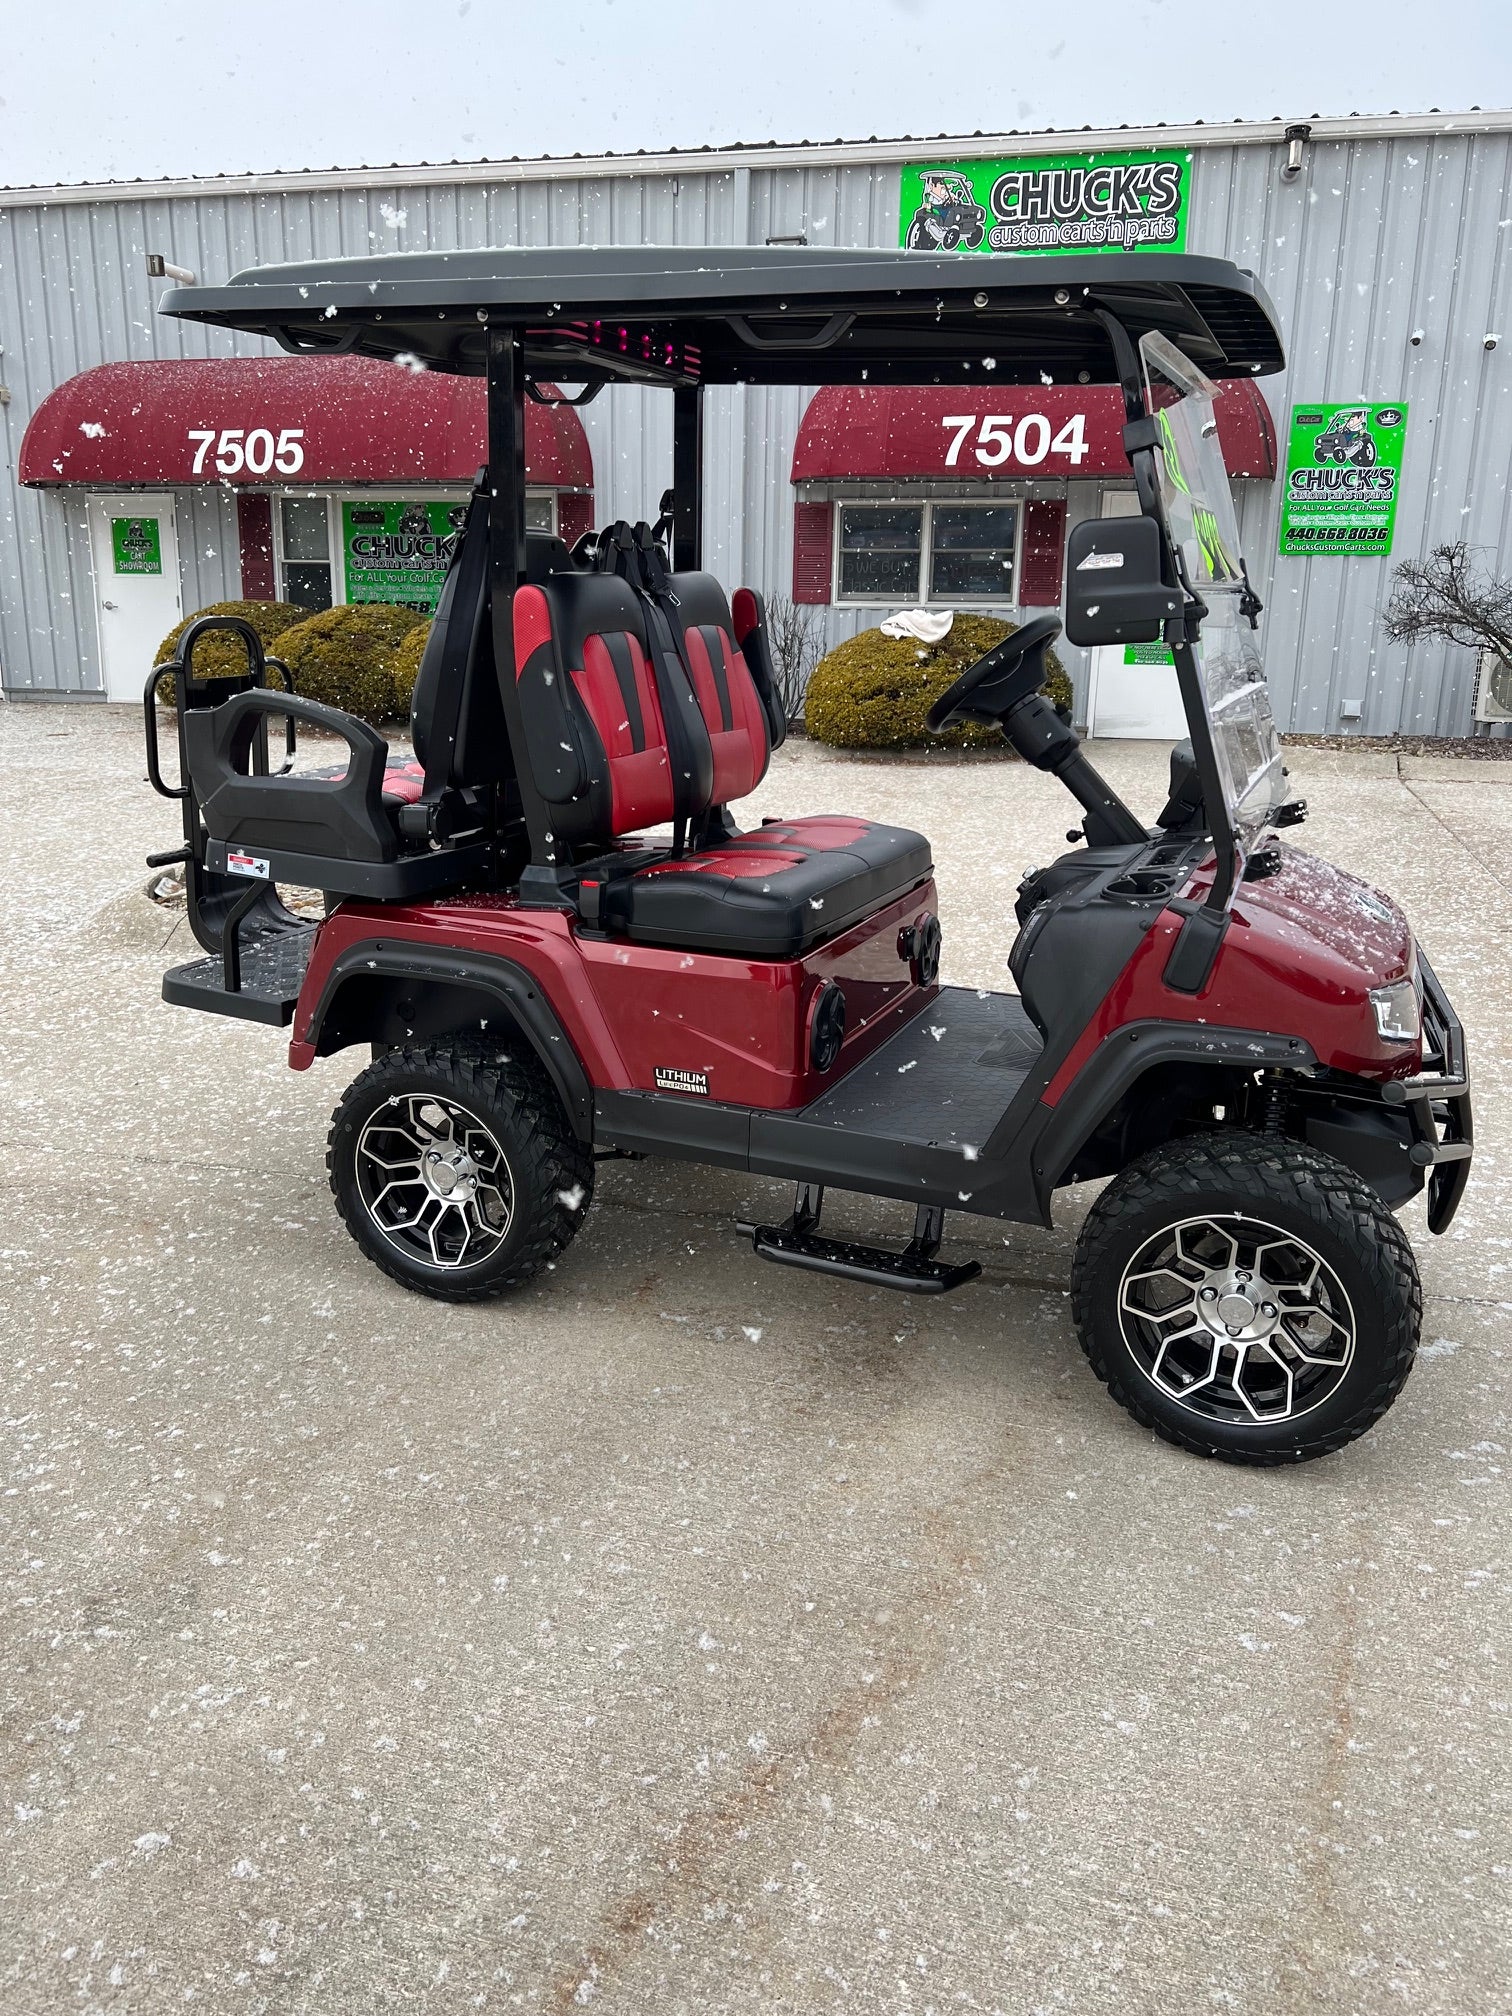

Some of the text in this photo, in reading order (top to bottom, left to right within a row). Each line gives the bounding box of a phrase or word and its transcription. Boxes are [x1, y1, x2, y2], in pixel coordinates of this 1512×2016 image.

[990, 163, 1182, 221] CHUCK'S
[989, 221, 1058, 247] custom
[1126, 216, 1176, 247] parts
[942, 413, 1090, 466] 7504
[188, 428, 304, 474] 7505
[1291, 468, 1396, 490] CHUCK'S
[1289, 504, 1300, 512] For
[1316, 504, 1332, 512] Your
[1366, 503, 1390, 511] Needs
[1285, 543, 1385, 551] ChucksCustomCarts.com
[119, 561, 159, 570] SHOWROOM
[352, 558, 399, 569] custom
[349, 572, 445, 583] For ALL Your Golf Ca
[655, 1068, 706, 1085] LITHIUM
